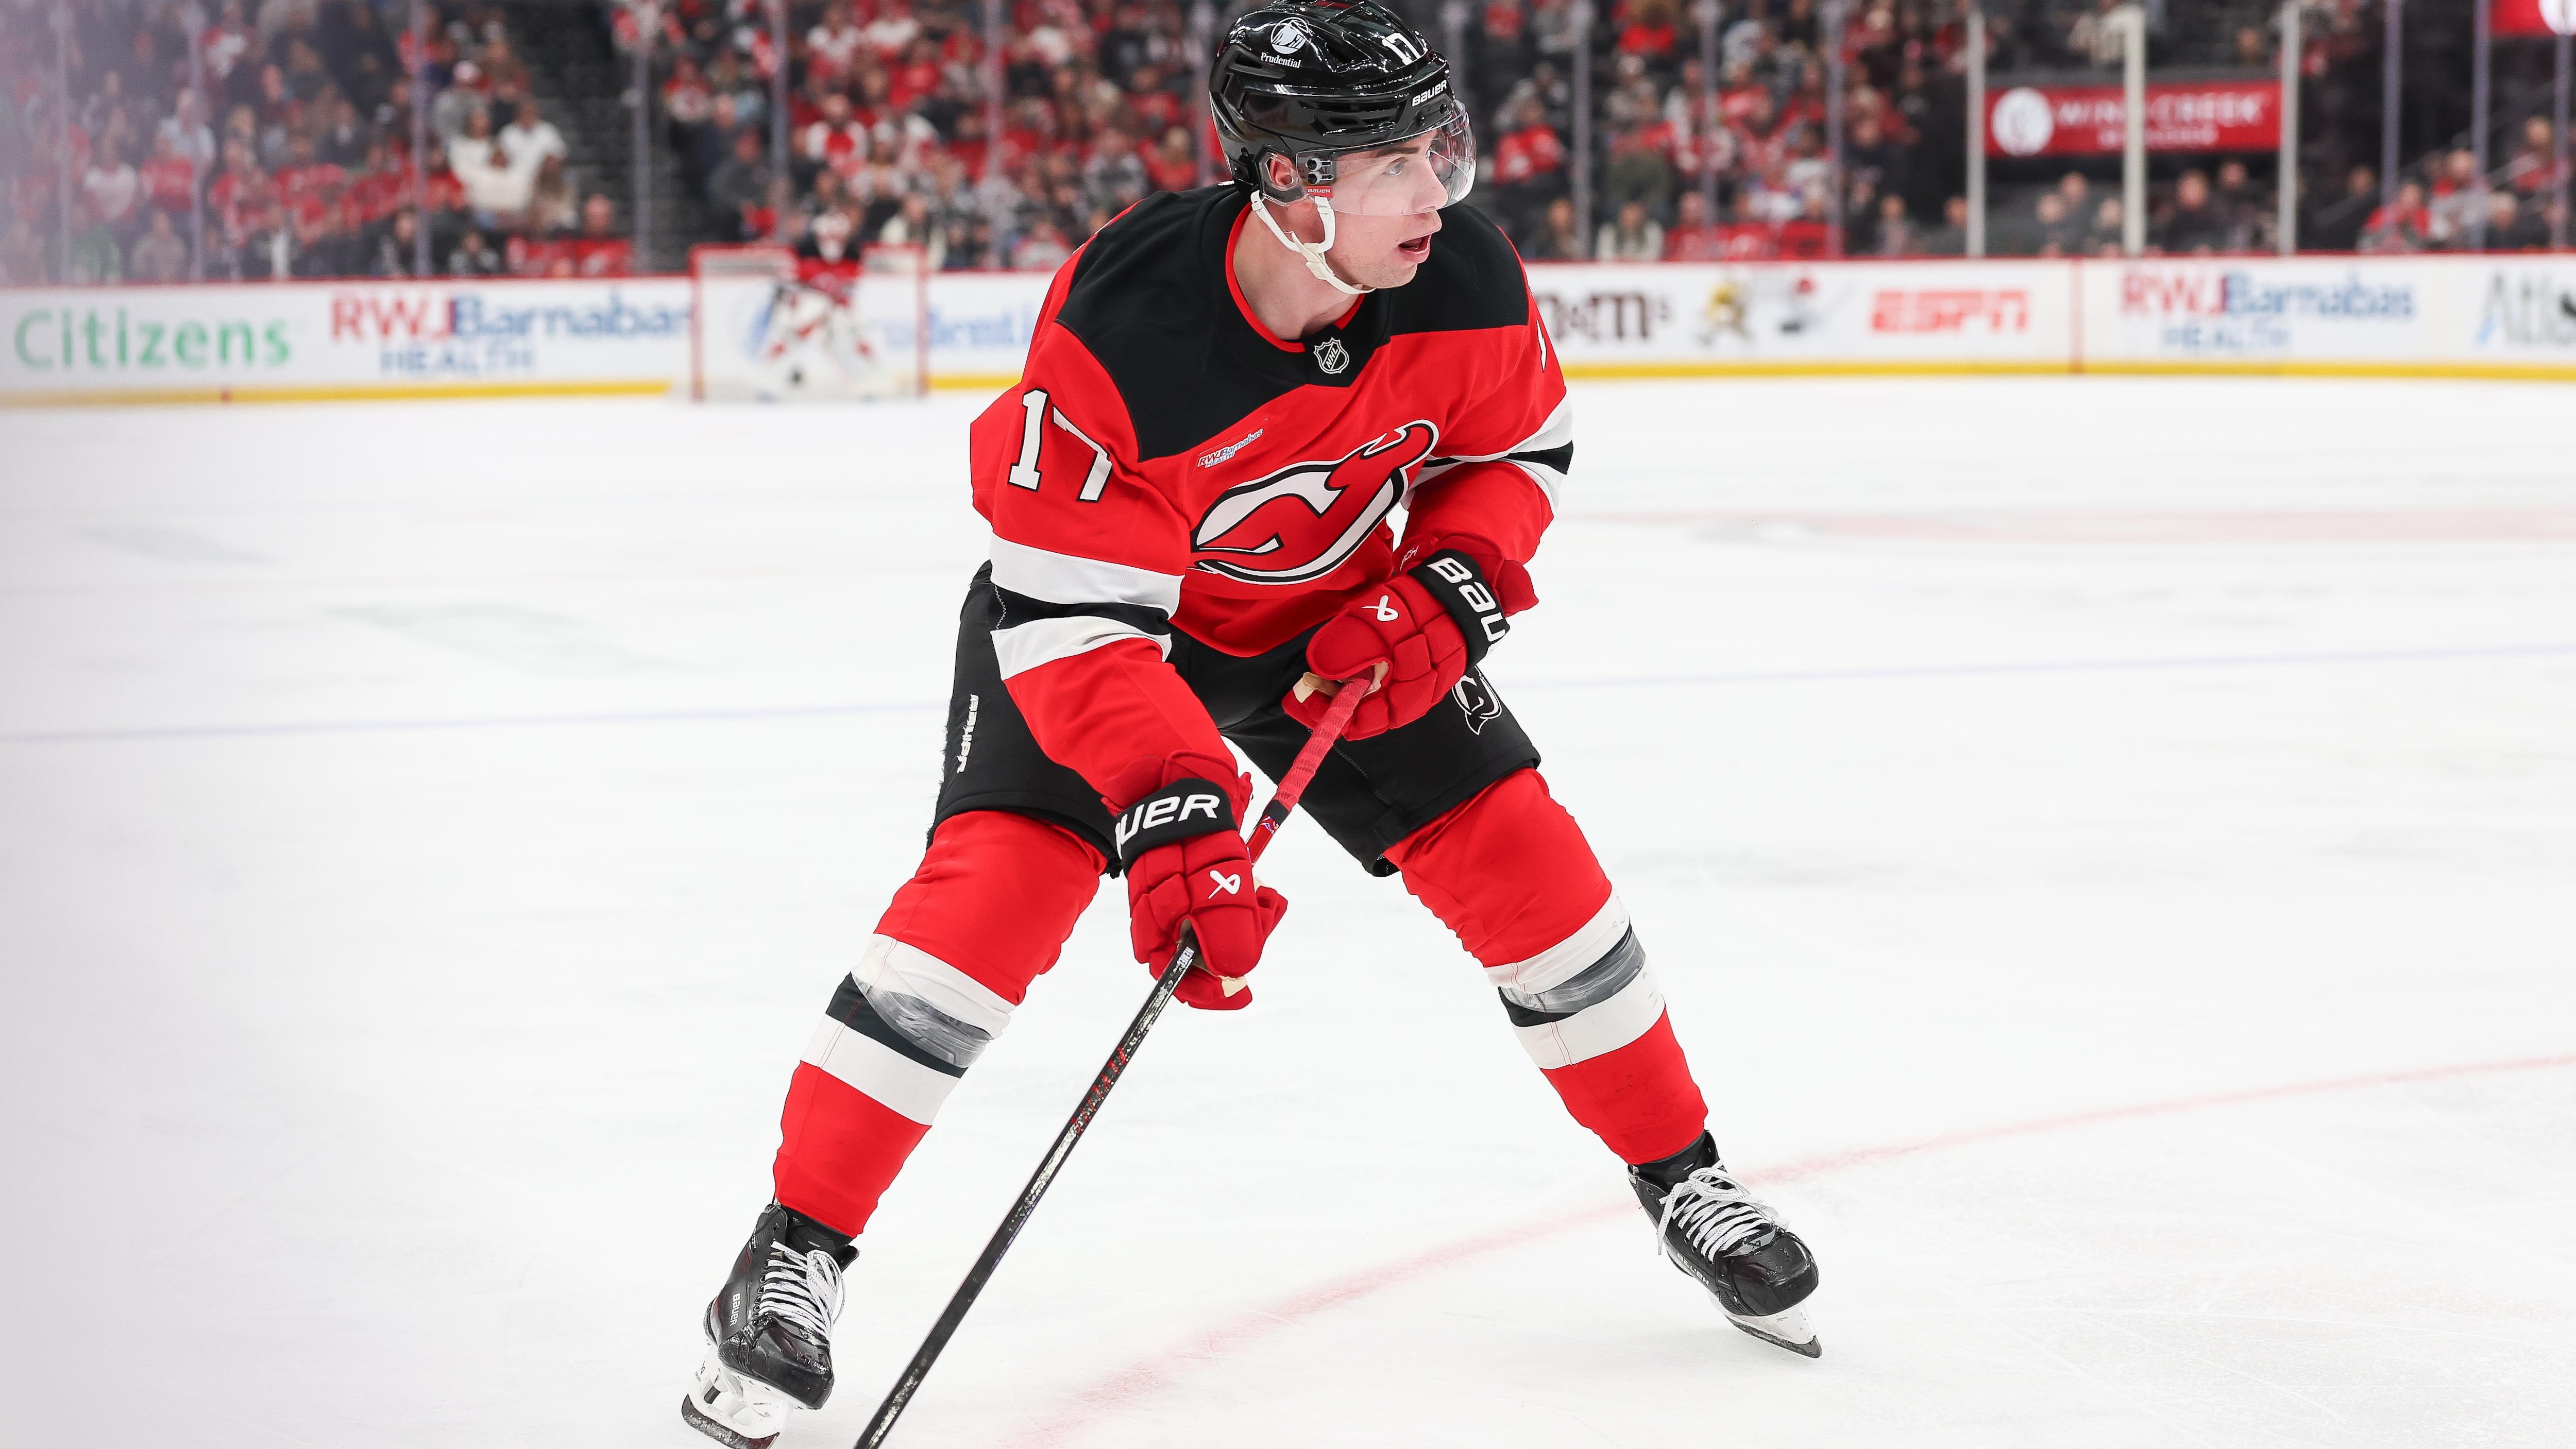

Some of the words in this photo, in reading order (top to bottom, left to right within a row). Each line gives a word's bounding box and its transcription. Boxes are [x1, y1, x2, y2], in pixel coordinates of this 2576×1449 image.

[1260, 52, 1302, 68] Prudential
[1382, 32, 1421, 66] 17
[1412, 79, 1447, 107] BAUER
[331, 290, 689, 340] RWJBarnaba
[1871, 288, 2028, 333] ESPN
[14, 306, 291, 370] Citizens
[1326, 347, 1338, 368] NHL
[1007, 387, 1113, 503] 17
[1198, 430, 1263, 466] RWJBarnabas
[1206, 453, 1235, 467] HEALTH
[1115, 794, 1220, 860] UER
[1177, 946, 1195, 968] NEMEC
[729, 1292, 740, 1327] BAUER
